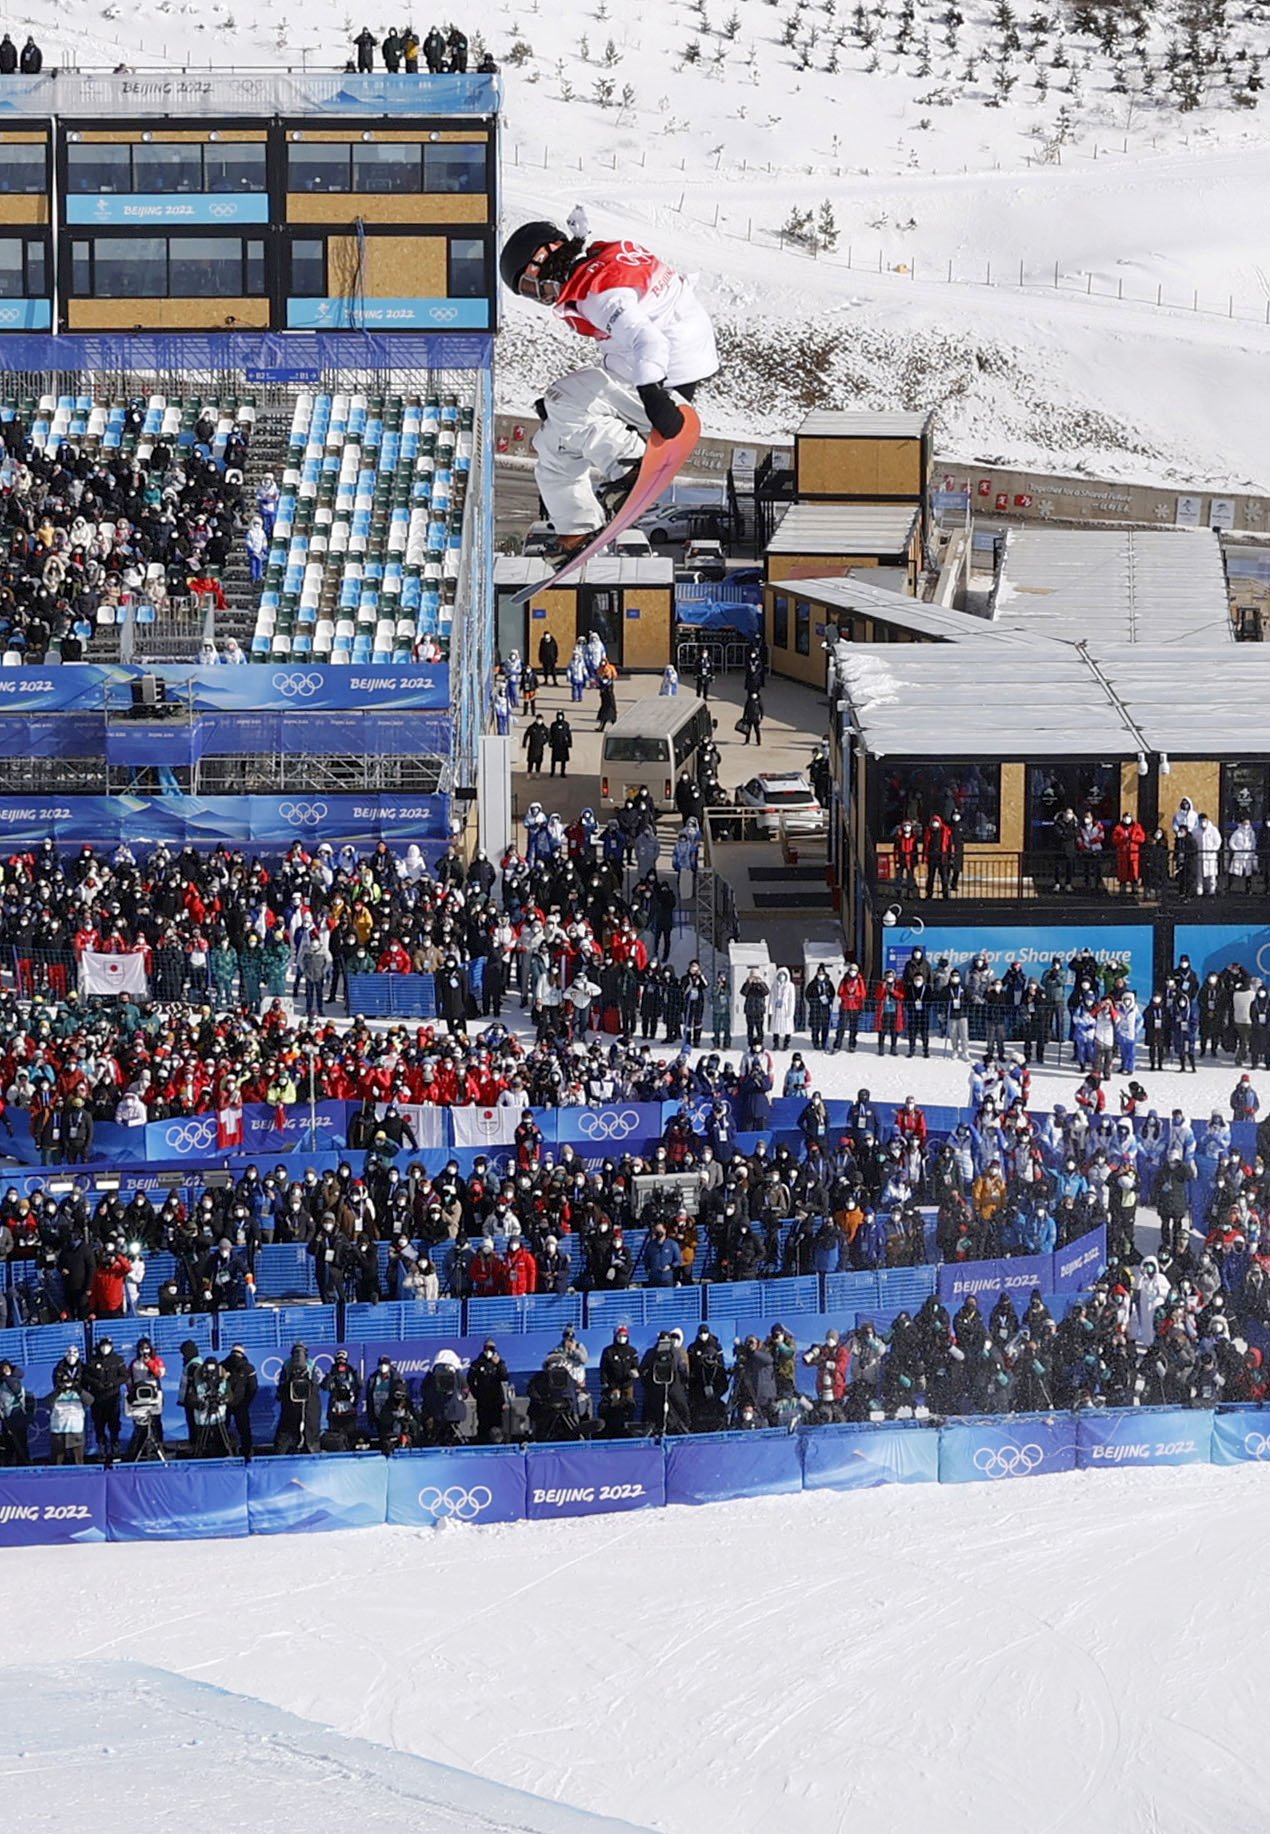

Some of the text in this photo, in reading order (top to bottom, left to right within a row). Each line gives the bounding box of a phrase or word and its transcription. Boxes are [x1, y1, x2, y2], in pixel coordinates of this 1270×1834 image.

[122, 81, 214, 96] BEIJING 2022
[123, 204, 163, 217] BEIJING
[165, 205, 195, 215] 2022
[386, 309, 415, 319] 2022
[19, 680, 55, 692] 2022
[350, 677, 435, 692] BEIJING 2022
[39, 808, 74, 820] 2022
[353, 807, 432, 820] BEIJING 2022
[925, 947, 975, 964] gether
[1004, 951, 1016, 963] a
[1019, 947, 1077, 963] Shared
[1083, 948, 1132, 962] uture
[1060, 1257, 1083, 1278] BEIJING
[953, 1274, 1041, 1295] BEIJING 2022
[1092, 1440, 1199, 1462] BEIJING 2022
[532, 1483, 646, 1506] BEIJING 2022
[43, 1505, 92, 1520] 2022
